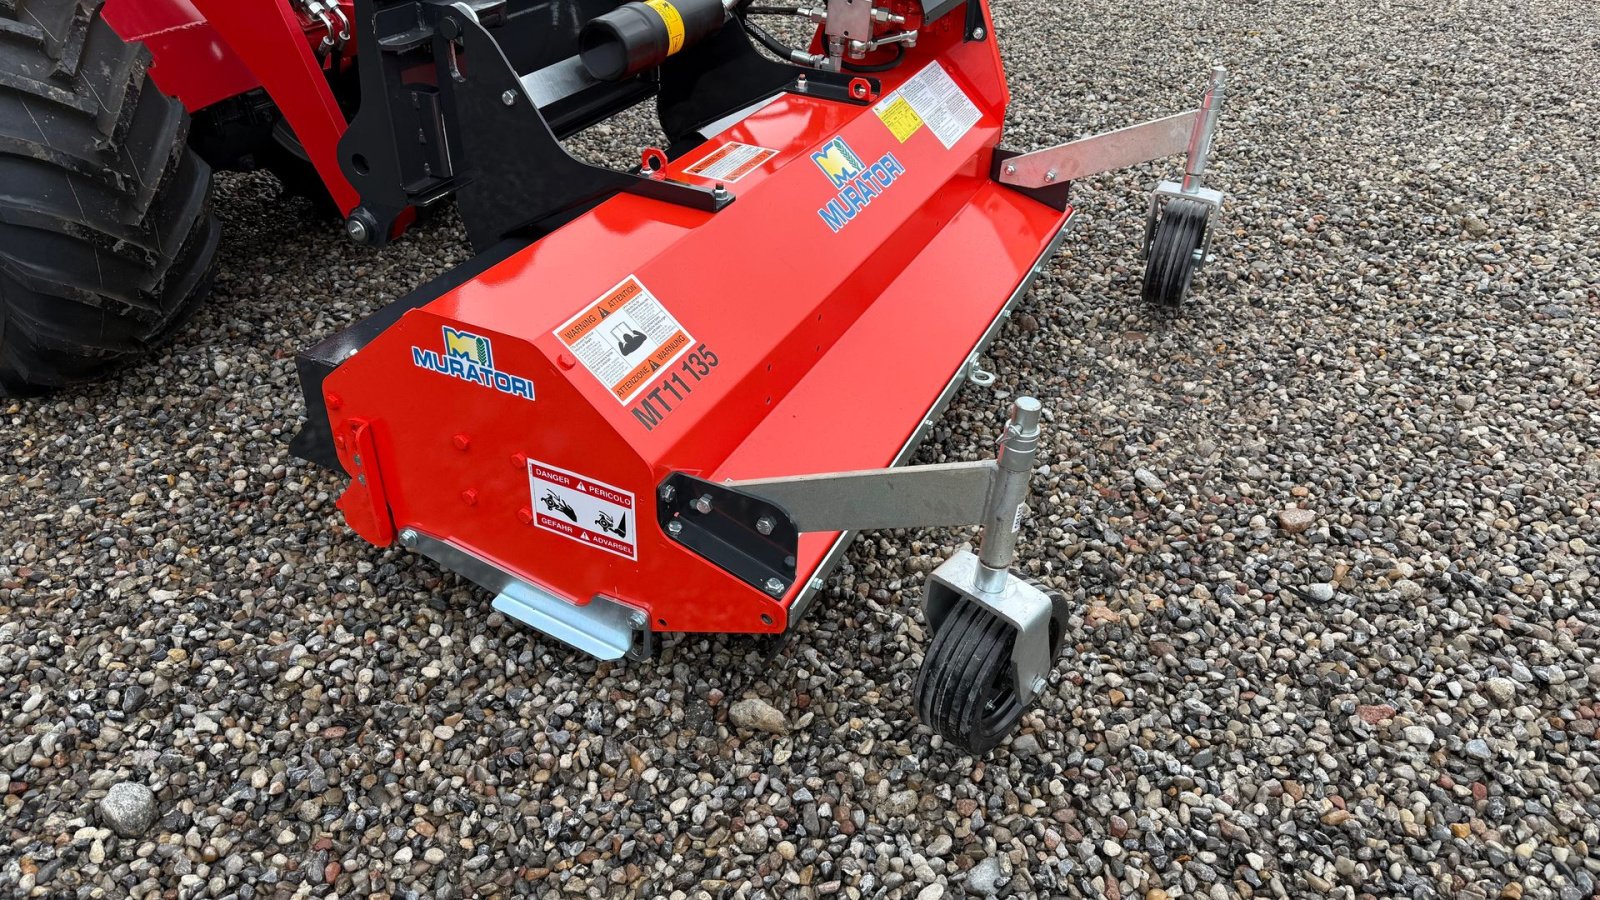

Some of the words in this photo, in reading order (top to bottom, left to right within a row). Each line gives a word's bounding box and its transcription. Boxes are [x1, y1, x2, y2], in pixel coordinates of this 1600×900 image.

[818, 152, 906, 234] MURATORI
[565, 314, 597, 340] WARNING
[608, 283, 637, 309] ATTENTION
[412, 346, 536, 401] MURATORI
[616, 366, 650, 398] ATTENZIONE
[656, 334, 686, 361] WARNUNG
[631, 371, 692, 431] MT11
[682, 343, 719, 382] 135
[535, 468, 570, 485] DANGER
[589, 485, 631, 506] PERICOLO
[541, 517, 573, 533] GEFAHR
[593, 535, 633, 554] ADVARSEL
